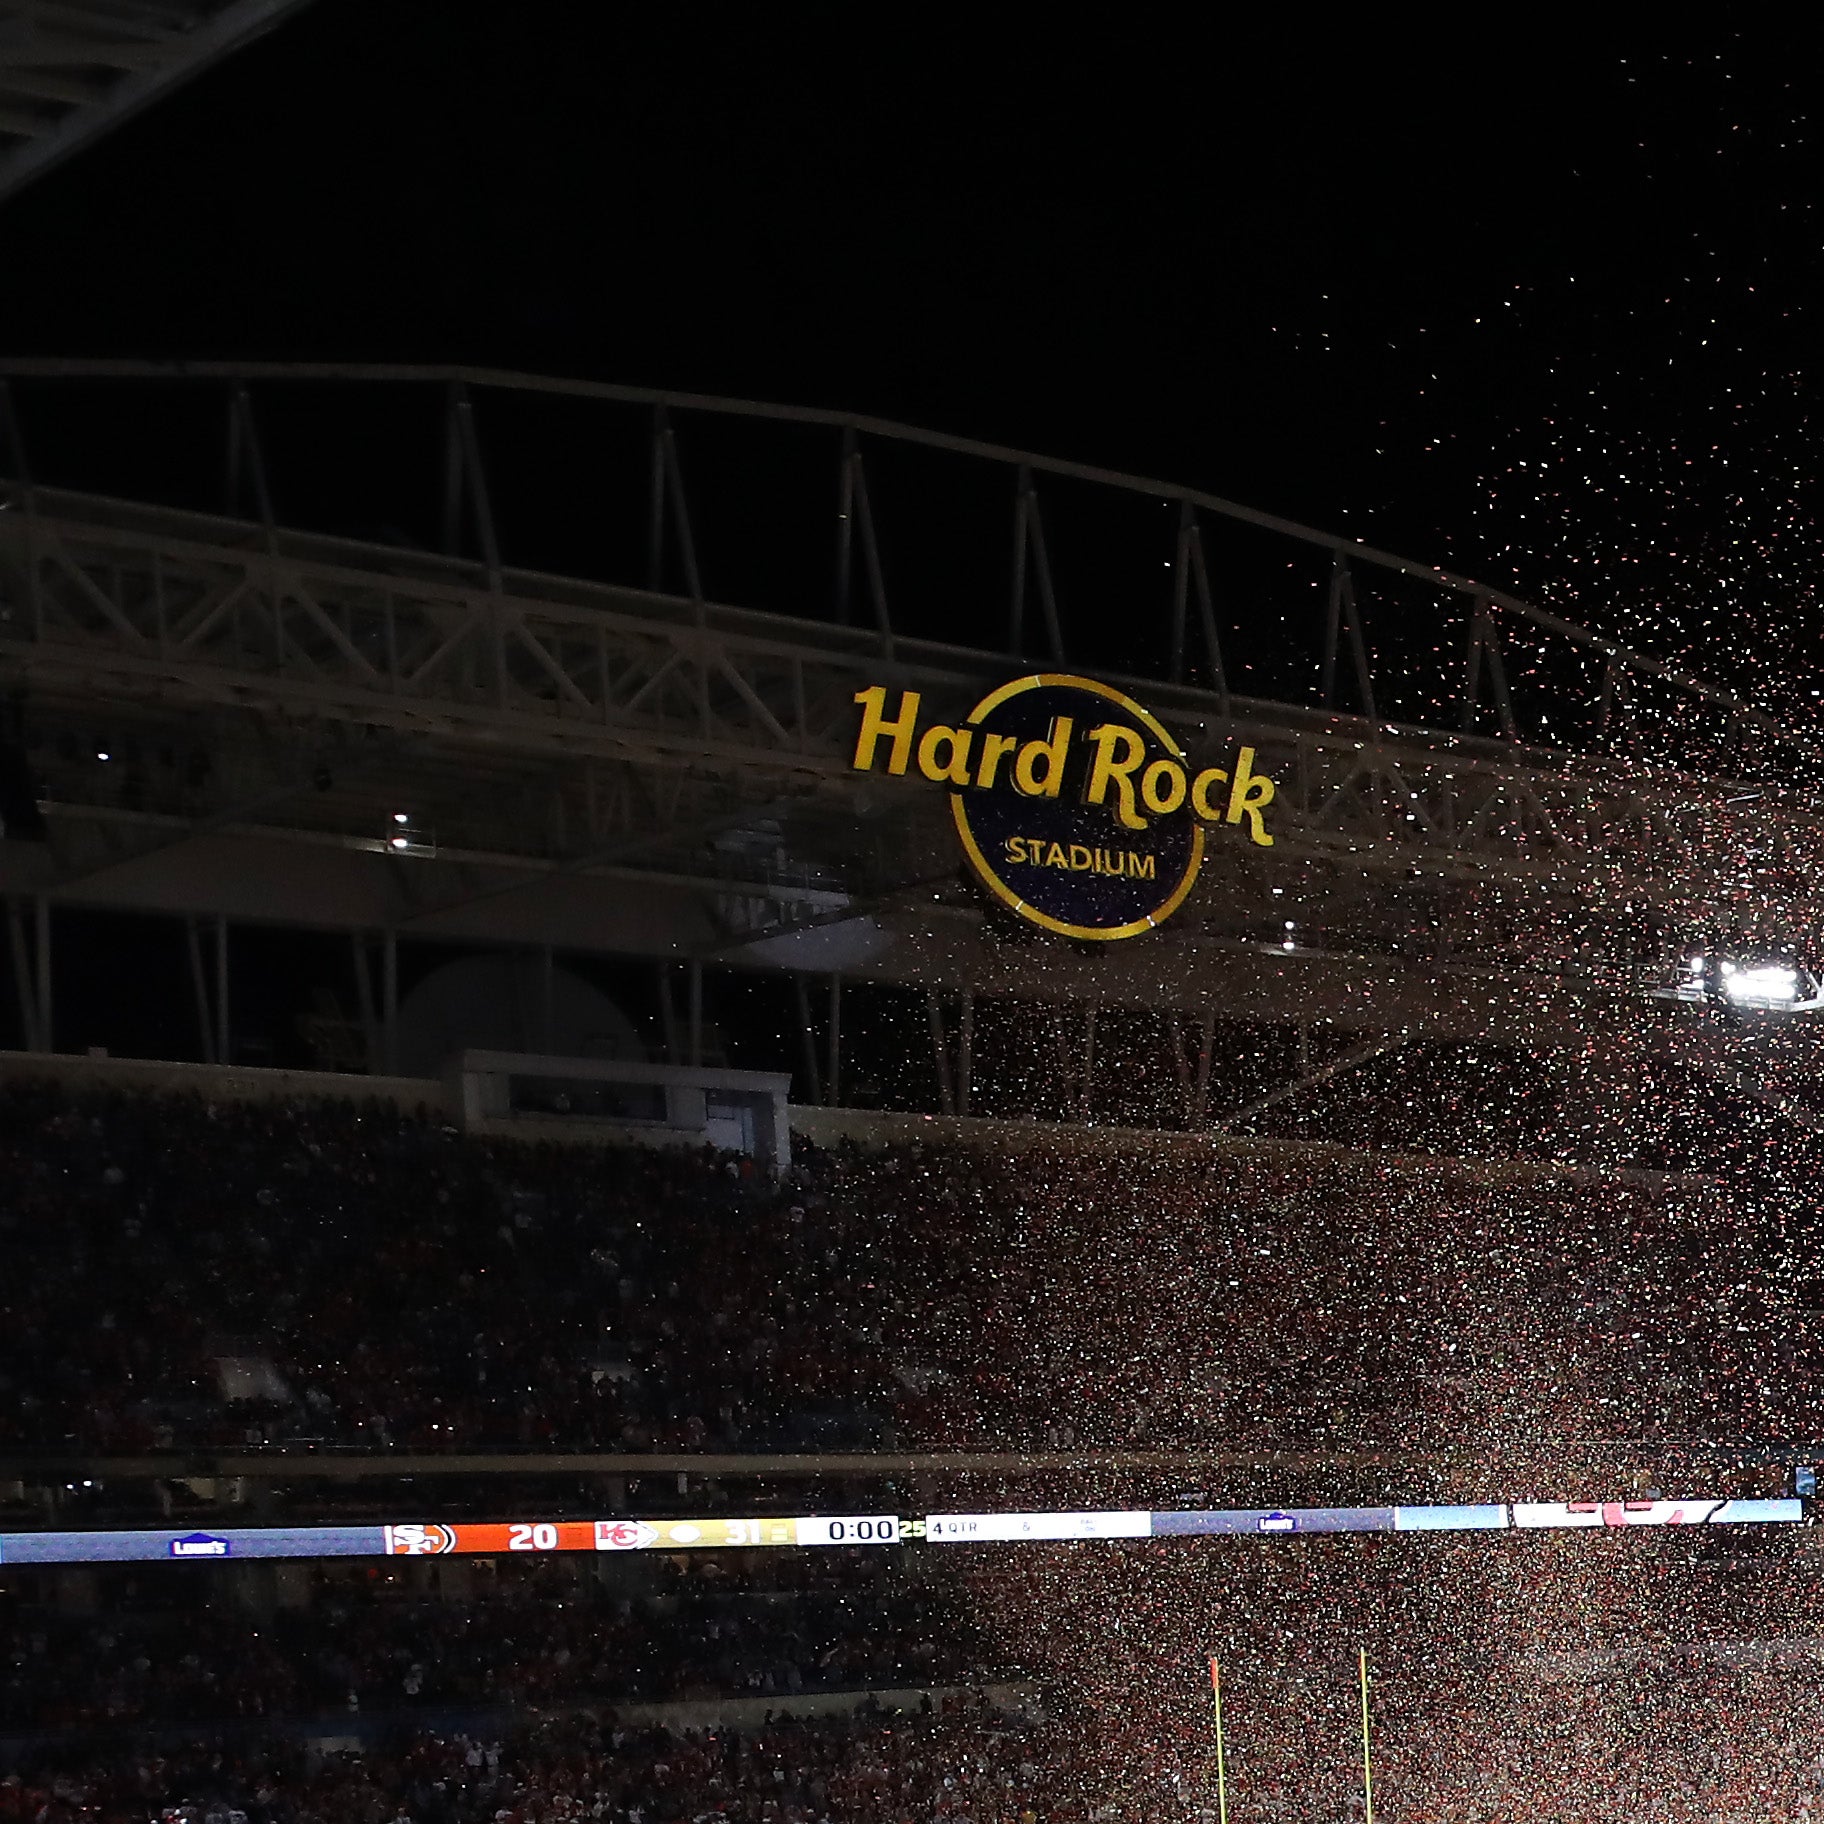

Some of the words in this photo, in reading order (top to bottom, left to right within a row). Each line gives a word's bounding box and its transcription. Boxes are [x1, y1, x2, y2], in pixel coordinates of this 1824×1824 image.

[854, 686, 1073, 798] Hard
[1083, 722, 1276, 846] Rock
[1005, 836, 1157, 880] STADIUM
[508, 1523, 557, 1550] 20
[724, 1519, 762, 1545] 31
[828, 1519, 893, 1541] 0:00
[899, 1519, 927, 1538] 25
[932, 1521, 943, 1535] 4
[948, 1521, 978, 1534] QTR
